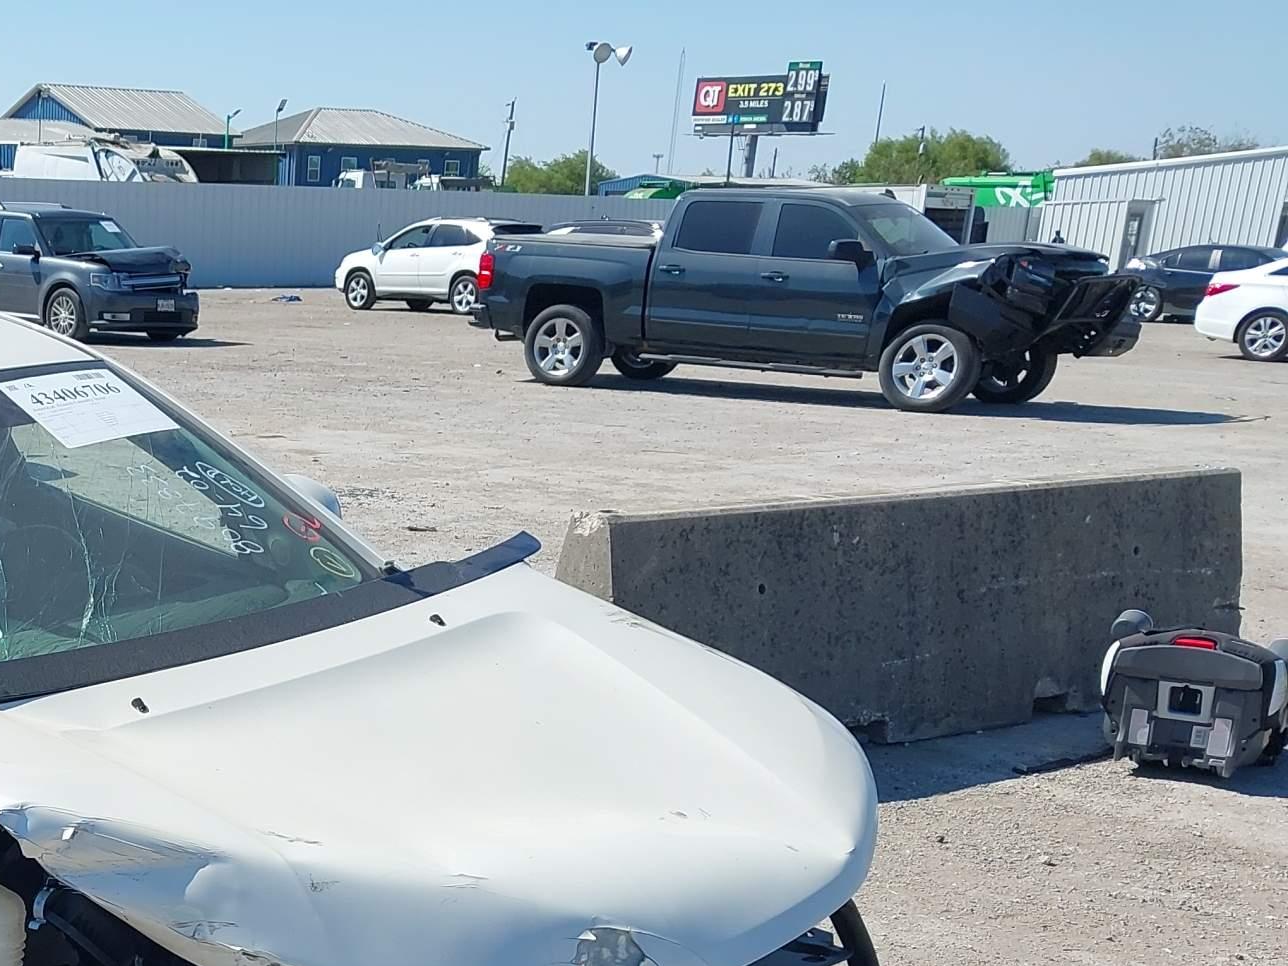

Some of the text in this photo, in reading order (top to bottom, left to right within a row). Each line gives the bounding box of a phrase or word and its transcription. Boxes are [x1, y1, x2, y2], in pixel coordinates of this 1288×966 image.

[699, 82, 785, 107] QT EXIT 273
[749, 100, 769, 108] MILES
[29, 382, 122, 407] 43406706
